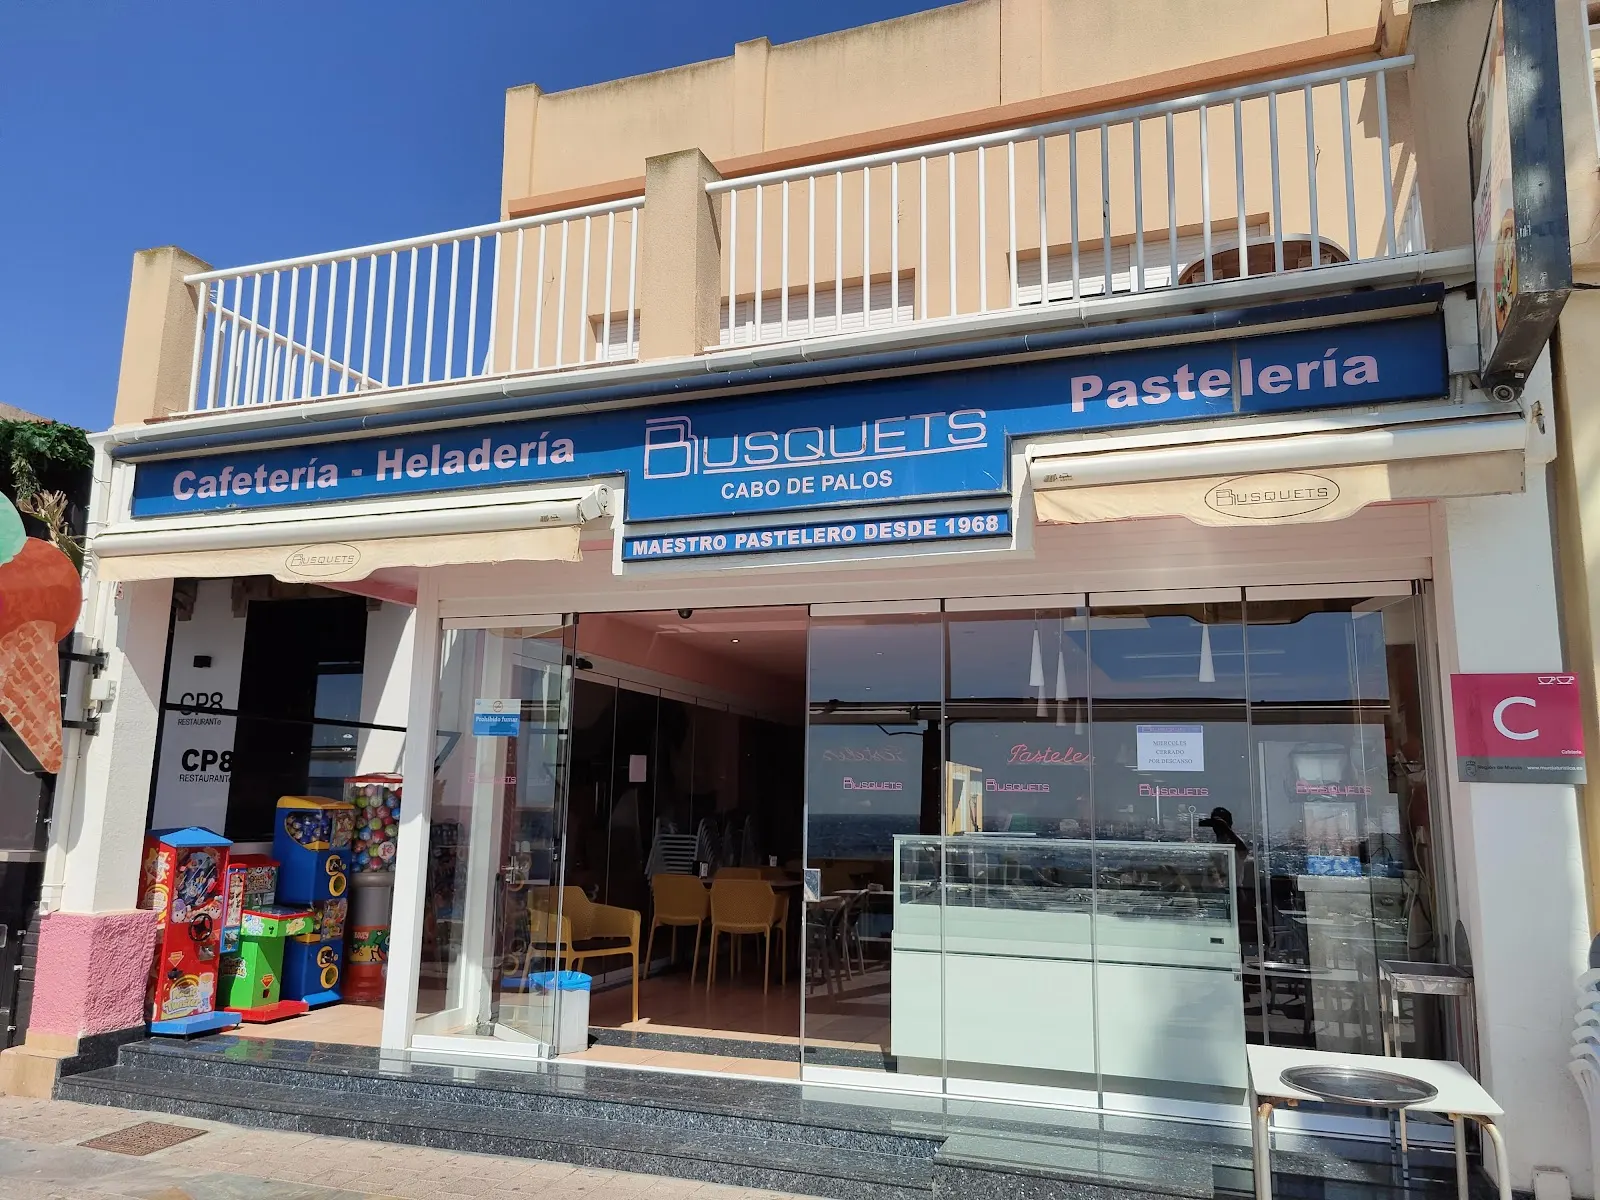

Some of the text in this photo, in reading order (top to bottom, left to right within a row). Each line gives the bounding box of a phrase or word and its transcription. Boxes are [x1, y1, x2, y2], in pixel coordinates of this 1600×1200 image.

[1070, 347, 1380, 414] Pastelería
[643, 408, 988, 480] BUSQUETS
[172, 457, 339, 502] Cafetería
[376, 432, 576, 482] Heladería
[721, 469, 894, 501] CABO DE PALOS
[1216, 484, 1329, 507] BUSQUETS
[632, 513, 1000, 557] MAESTRO PASTELERO DESDE 1968
[290, 552, 355, 568] BUSQUETS
[1492, 696, 1539, 741] C
[181, 748, 234, 773] CP8
[1006, 743, 1096, 764] Pastele
[842, 776, 903, 791] BUSQUETS
[985, 778, 1051, 793] BUSQUETS
[1138, 784, 1209, 796] BUSQUETS
